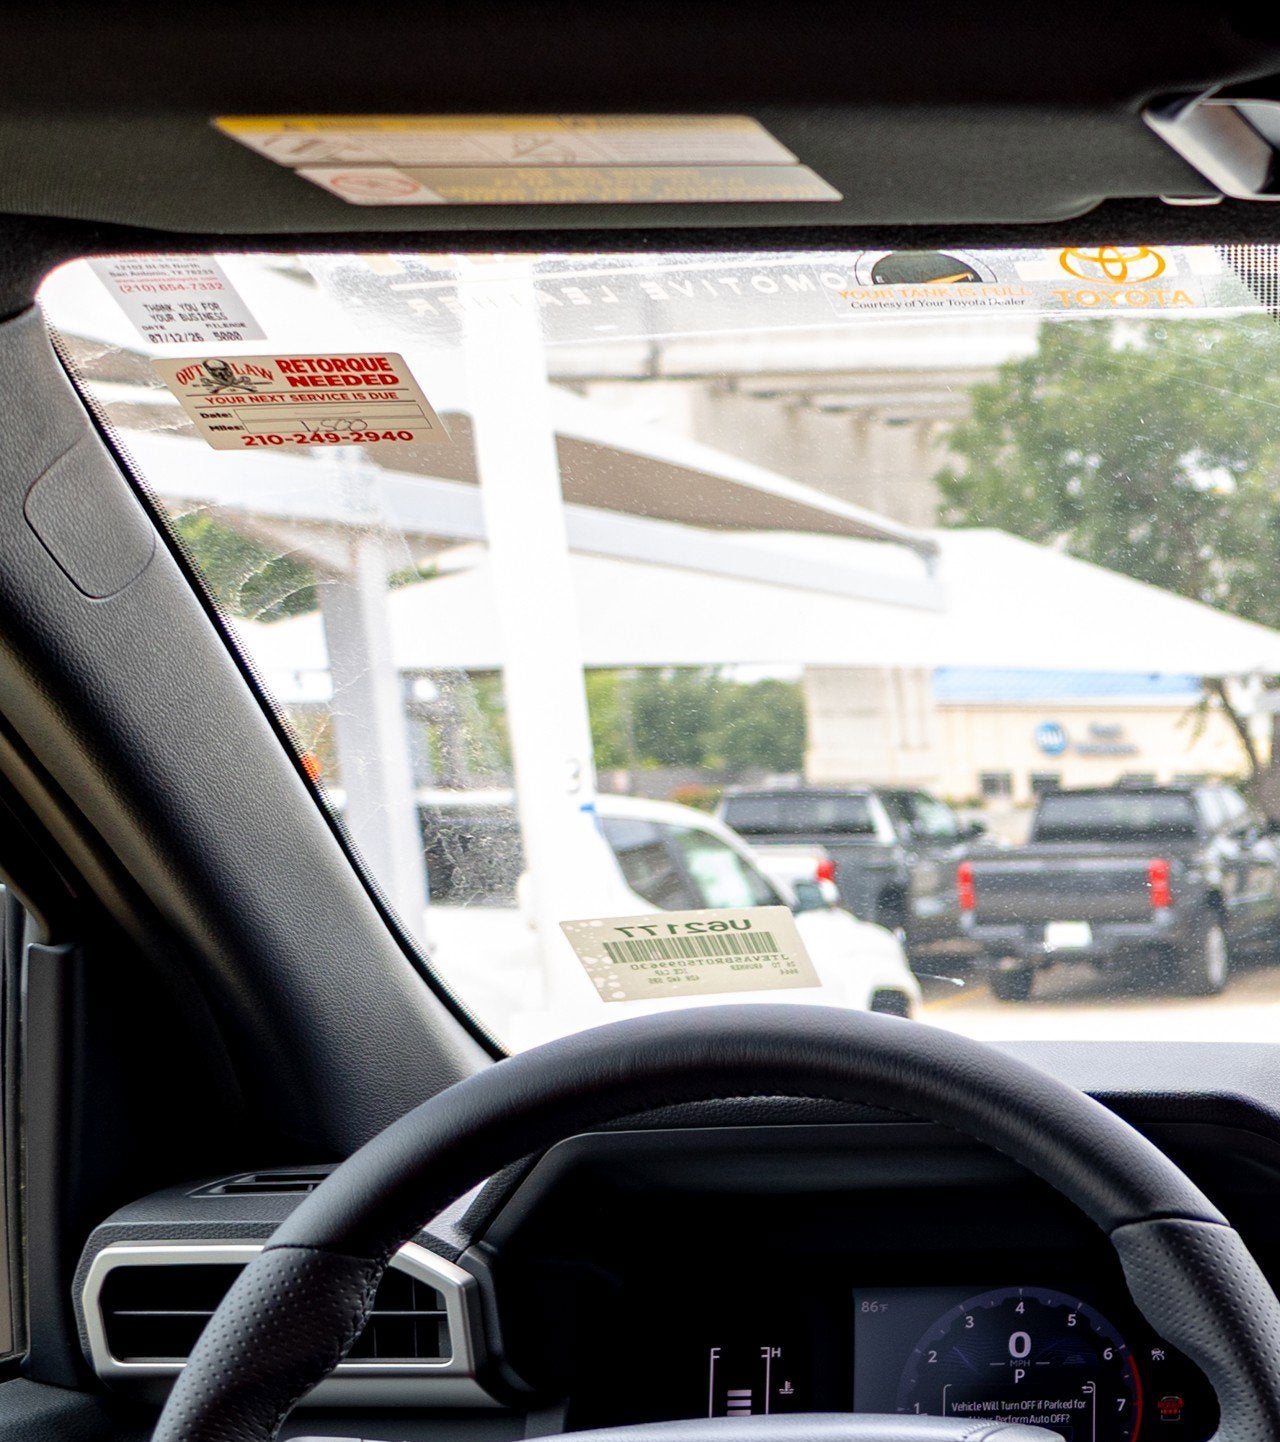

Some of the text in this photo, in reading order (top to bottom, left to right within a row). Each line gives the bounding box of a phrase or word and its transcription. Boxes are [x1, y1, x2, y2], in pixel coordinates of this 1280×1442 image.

[119, 284, 157, 293] (210)
[837, 285, 1031, 301] YOUR TANK IS FULL
[851, 298, 1025, 310] Courtesy of Your Toyota Dealer
[1051, 289, 1194, 307] TOYOTA
[143, 302, 221, 312] THANK YOU FOR
[150, 312, 228, 322] YOUR BUSINESS
[149, 332, 204, 344] 07/12/26
[275, 357, 394, 374] RETORQUE
[285, 373, 400, 388] NEEDED
[205, 391, 399, 406] YOUR NEXT SERVICE IS DUE
[209, 423, 244, 432] Miles:
[241, 430, 414, 447] 210-249-2940
[1015, 1302, 1025, 1314] 4
[965, 1316, 975, 1328] 3
[1067, 1314, 1077, 1327] 5
[1008, 1331, 1032, 1359] 0
[927, 1350, 938, 1363] 2
[1103, 1348, 1113, 1360] 6
[1010, 1359, 1031, 1367] MPH
[1014, 1369, 1026, 1384] P
[952, 1402, 983, 1412] Vehicle
[983, 1401, 999, 1411] Will
[1001, 1401, 1019, 1411] Turn
[1021, 1400, 1036, 1410] OFF
[1044, 1399, 1073, 1409] Parked
[1074, 1399, 1086, 1408] for
[1117, 1399, 1126, 1411] 7
[1029, 1414, 1050, 1424] Auto
[1050, 1414, 1070, 1423] OFF?
